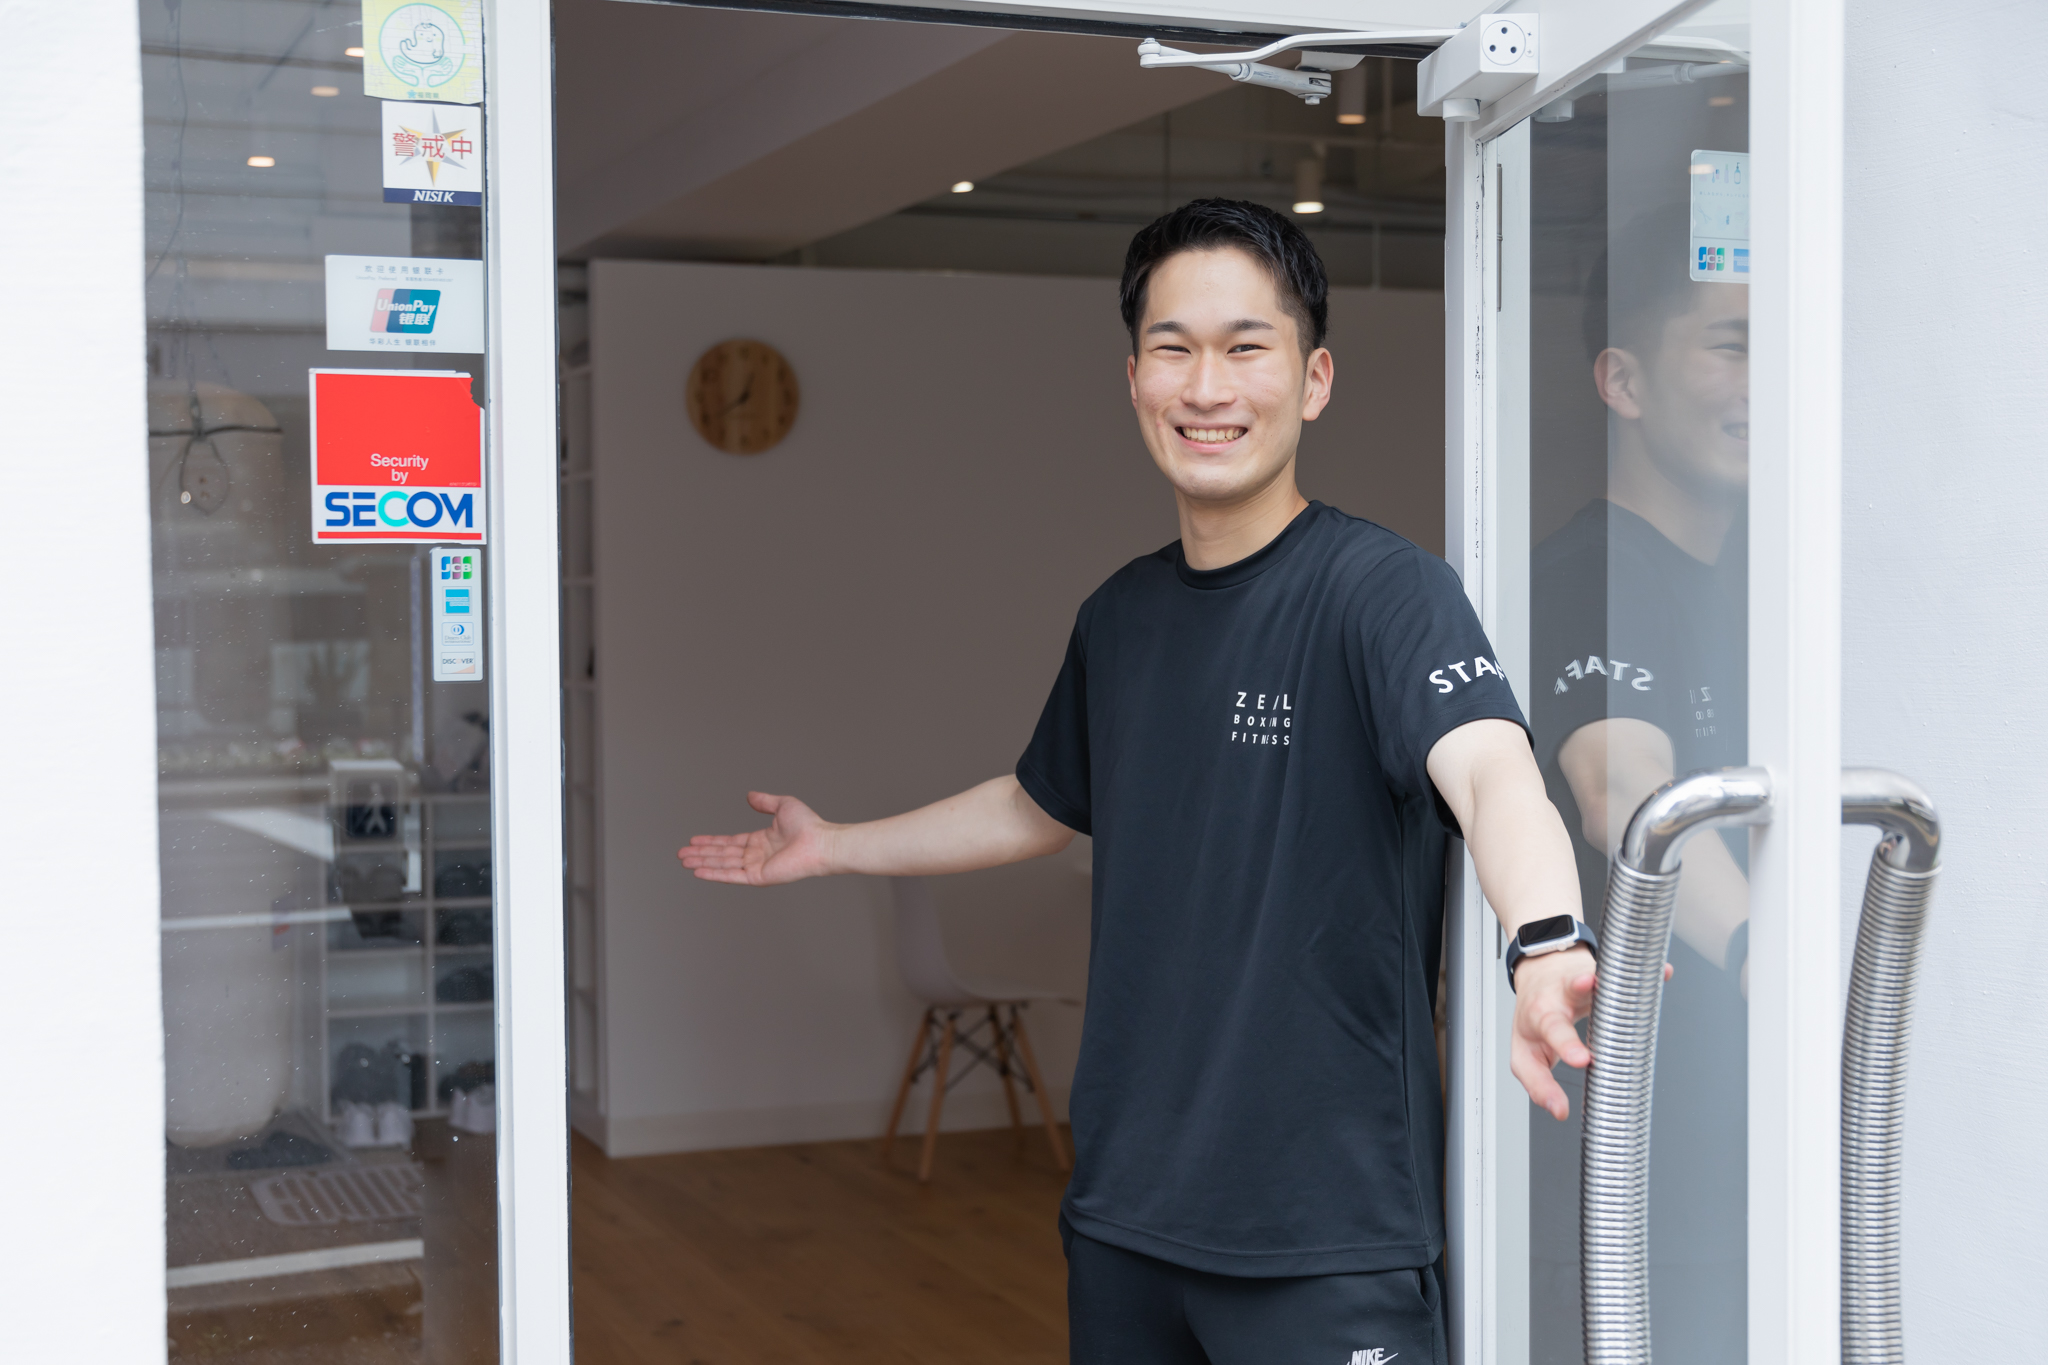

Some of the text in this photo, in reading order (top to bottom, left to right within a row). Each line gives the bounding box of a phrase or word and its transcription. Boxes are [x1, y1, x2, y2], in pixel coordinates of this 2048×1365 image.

[393, 132, 472, 160] 警戒中
[376, 298, 436, 316] UnionPay
[399, 312, 430, 325] 银联
[370, 453, 429, 471] Security
[391, 468, 408, 485] by
[325, 490, 473, 528] SECOM
[1351, 1347, 1385, 1365] NIKE
